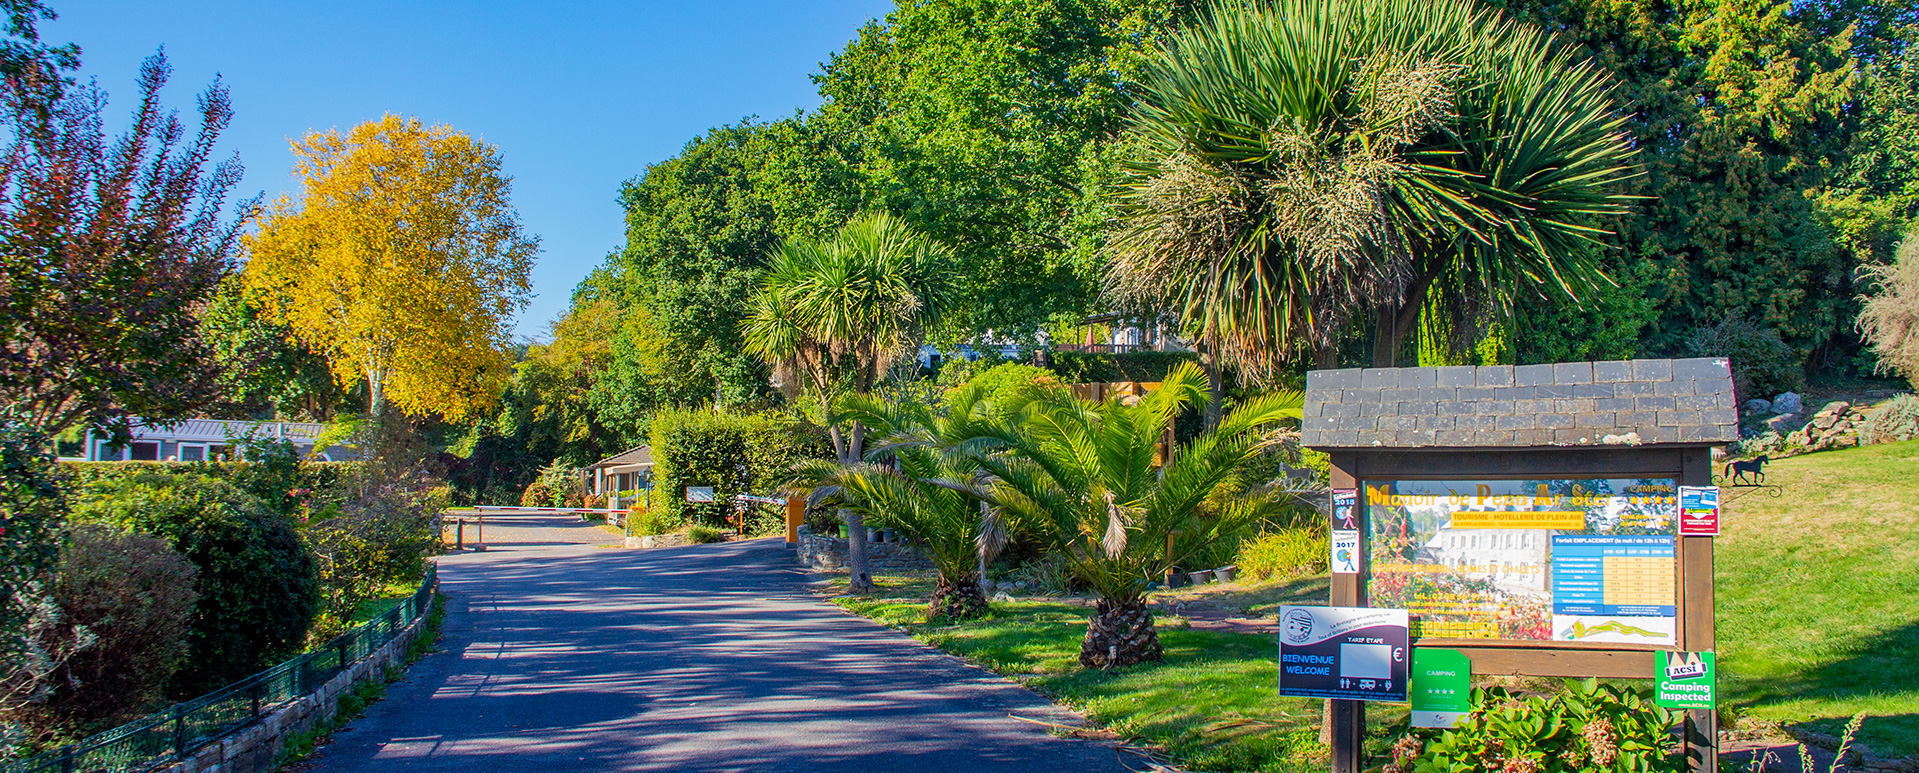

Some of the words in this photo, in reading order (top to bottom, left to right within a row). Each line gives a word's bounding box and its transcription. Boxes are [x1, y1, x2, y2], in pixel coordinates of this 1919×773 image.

[1630, 485, 1674, 493] CAMPING
[1366, 484, 1440, 506] Manoir
[1448, 489, 1470, 506] de
[1534, 484, 1565, 506] Ar
[1453, 513, 1489, 521] TOURISME
[1493, 513, 1535, 521] HOTELLERIE
[1536, 513, 1546, 521] DE
[1546, 513, 1582, 521] PLEIN-AIR
[1489, 564, 1499, 574] ET
[1501, 564, 1541, 574] CHALETS
[1282, 654, 1335, 665] BIENVENUE
[1286, 665, 1331, 676] WELCOME
[1661, 681, 1710, 693] Camping
[1660, 691, 1711, 702] Inspected
